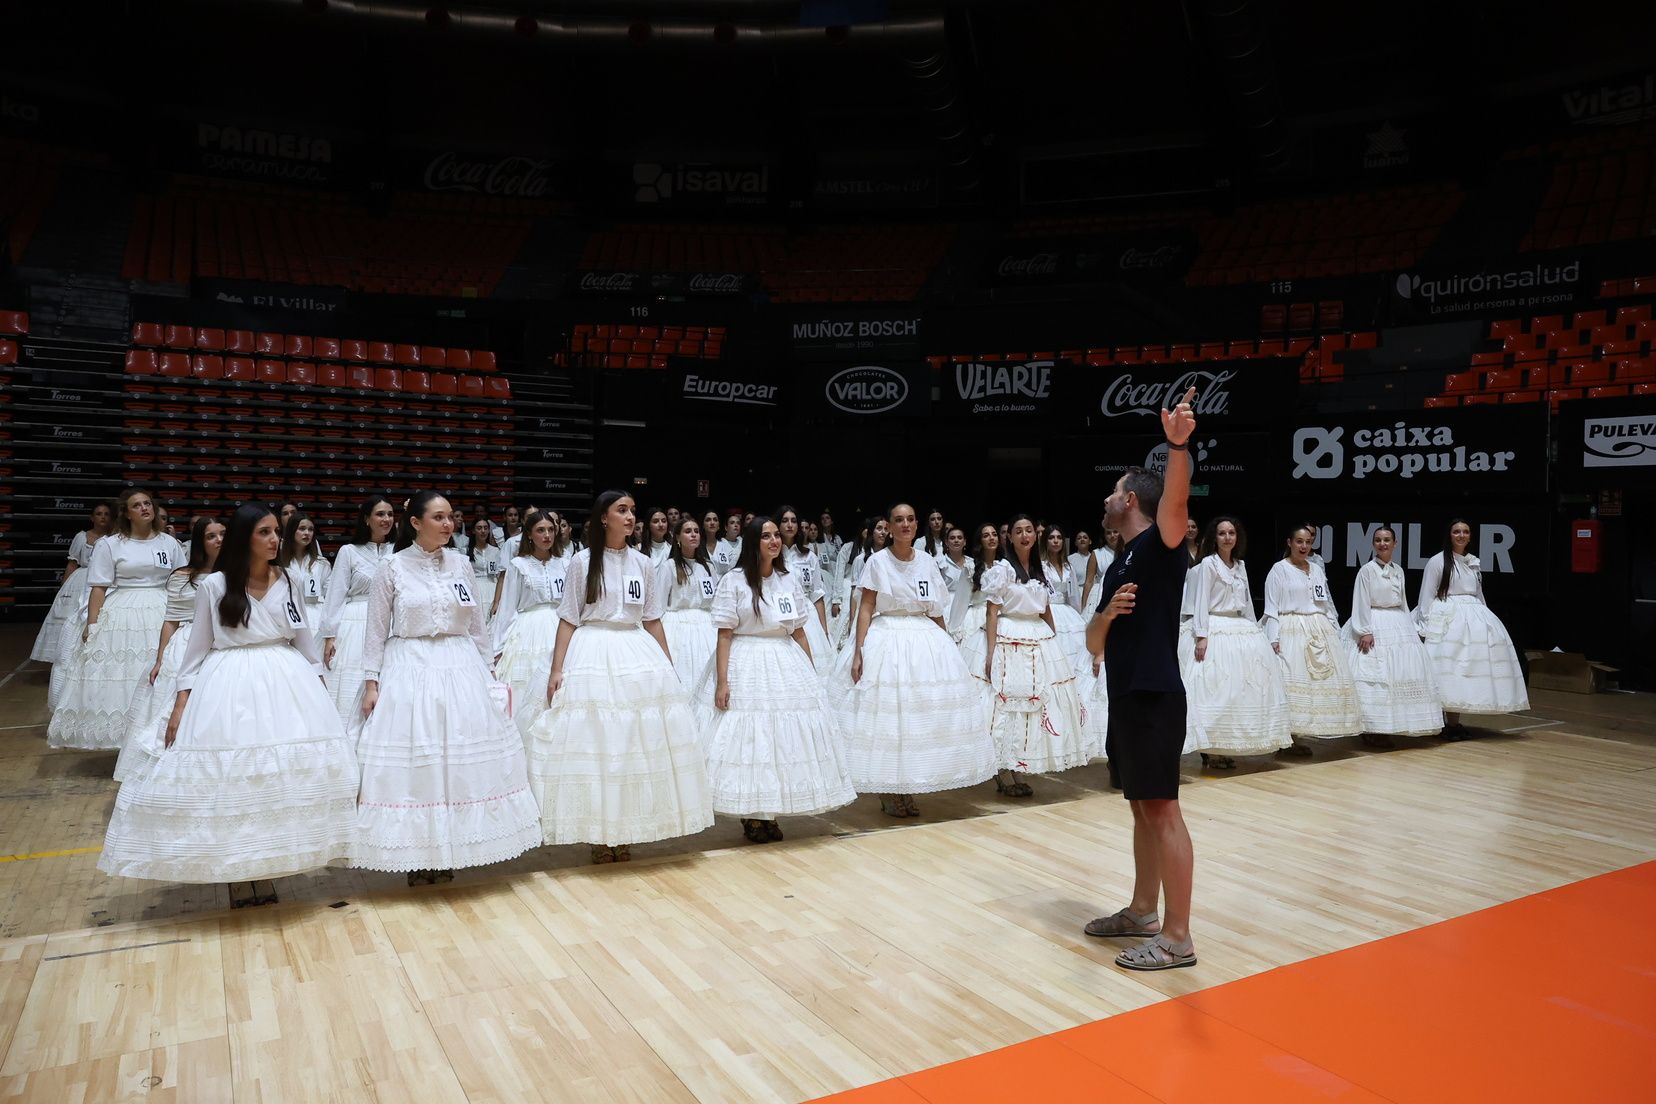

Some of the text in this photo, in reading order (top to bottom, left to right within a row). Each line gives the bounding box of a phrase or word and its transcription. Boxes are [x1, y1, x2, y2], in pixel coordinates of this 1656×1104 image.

[197, 122, 332, 163] PAMESA
[676, 164, 768, 192] isaval
[815, 180, 874, 192] AMSTEL
[1271, 281, 1292, 294] 115
[280, 297, 336, 311] Villar
[1443, 302, 1470, 313] salud
[1473, 296, 1516, 311] persona
[1528, 293, 1573, 308] persona
[630, 307, 649, 318] 116
[793, 320, 917, 338] MUÑOZ BOSCH
[683, 375, 778, 401] Europcar
[956, 361, 1055, 400] VELARTE
[834, 382, 899, 400] VALOR
[973, 403, 993, 413] Sabe
[53, 426, 84, 438] Torres
[1352, 422, 1453, 448] caixa
[1352, 446, 1516, 479] popular
[1346, 522, 1516, 574] MILR
[157, 551, 168, 565] 18
[310, 579, 316, 593] 2
[454, 583, 470, 602] 29
[554, 578, 564, 594] 12
[628, 583, 641, 600] 40
[702, 580, 713, 595] 53
[919, 580, 929, 597] 57
[1315, 585, 1324, 598] 62
[778, 597, 792, 614] 66
